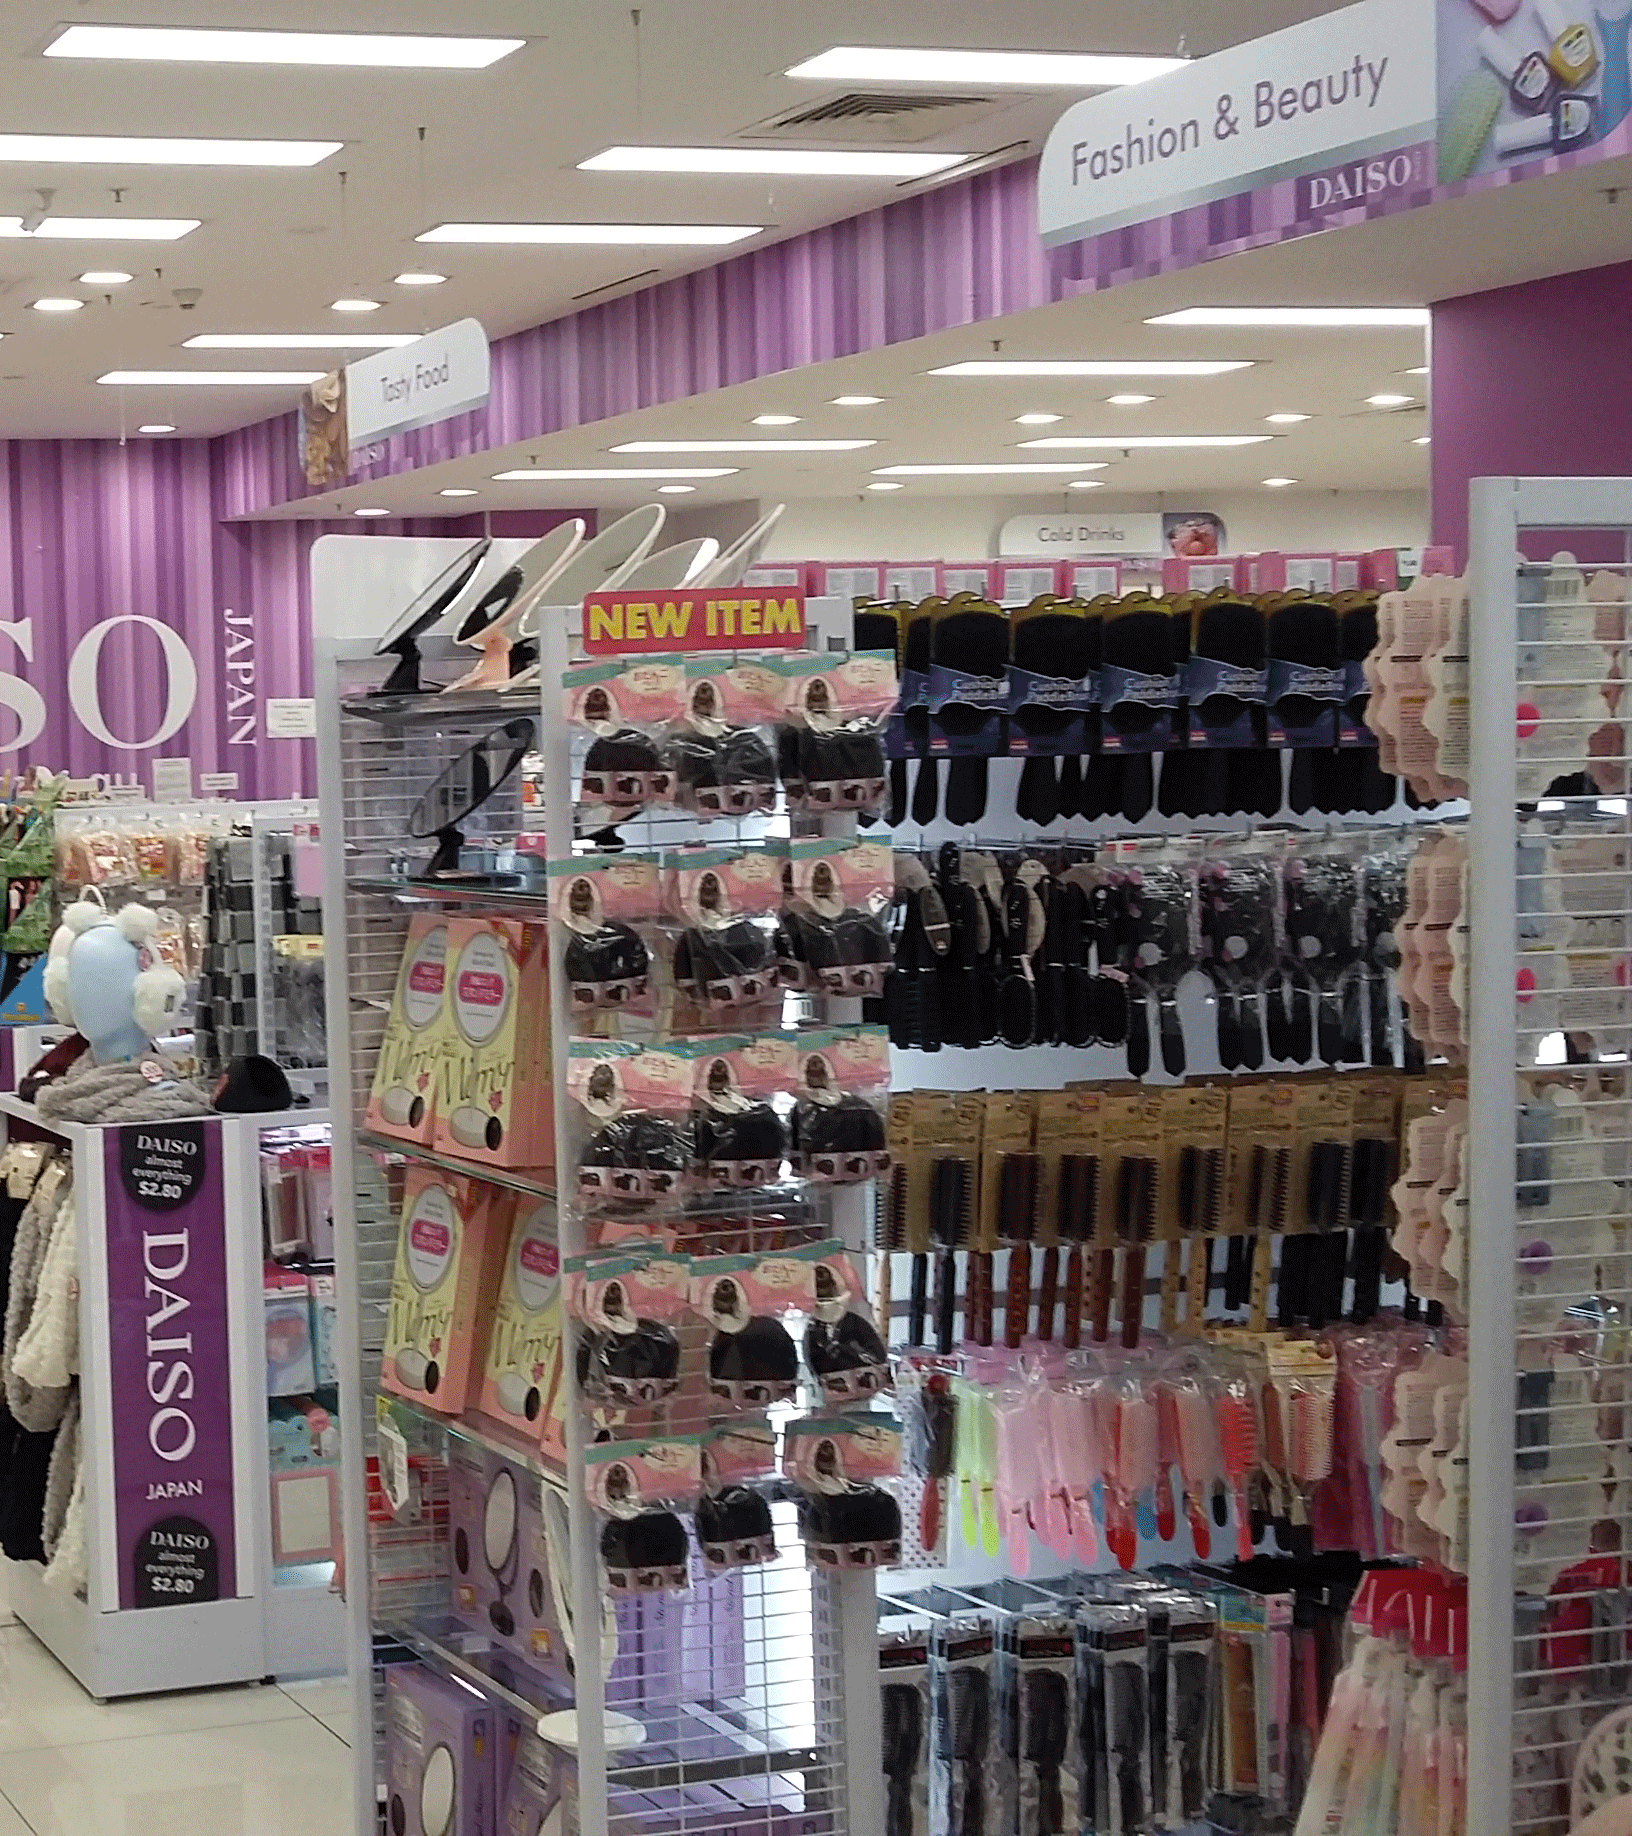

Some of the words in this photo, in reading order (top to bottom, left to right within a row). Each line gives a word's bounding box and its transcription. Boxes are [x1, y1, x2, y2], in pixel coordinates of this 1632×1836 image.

[1071, 117, 1200, 186] Fashion
[1214, 94, 1241, 140] &
[1254, 53, 1389, 130] Beauty
[1309, 154, 1412, 210] DAISO
[380, 373, 411, 403] Tasty
[415, 353, 449, 391] Food
[1037, 526, 1073, 542] Cold
[1078, 526, 1125, 542] Drinks
[588, 602, 693, 641] NEW
[705, 598, 802, 637] ITEM
[223, 608, 257, 746] JAPAN
[137, 1134, 197, 1156] DAISO
[144, 1155, 184, 1169] almost
[131, 1167, 192, 1186] everything
[138, 1181, 182, 1199] $2.80
[142, 1227, 197, 1462] DAISO
[145, 1479, 203, 1500] JAPAN
[150, 1531, 210, 1550] DAISO
[157, 1551, 196, 1564] almost
[145, 1564, 205, 1580] everything
[151, 1576, 194, 1593] $2.80
